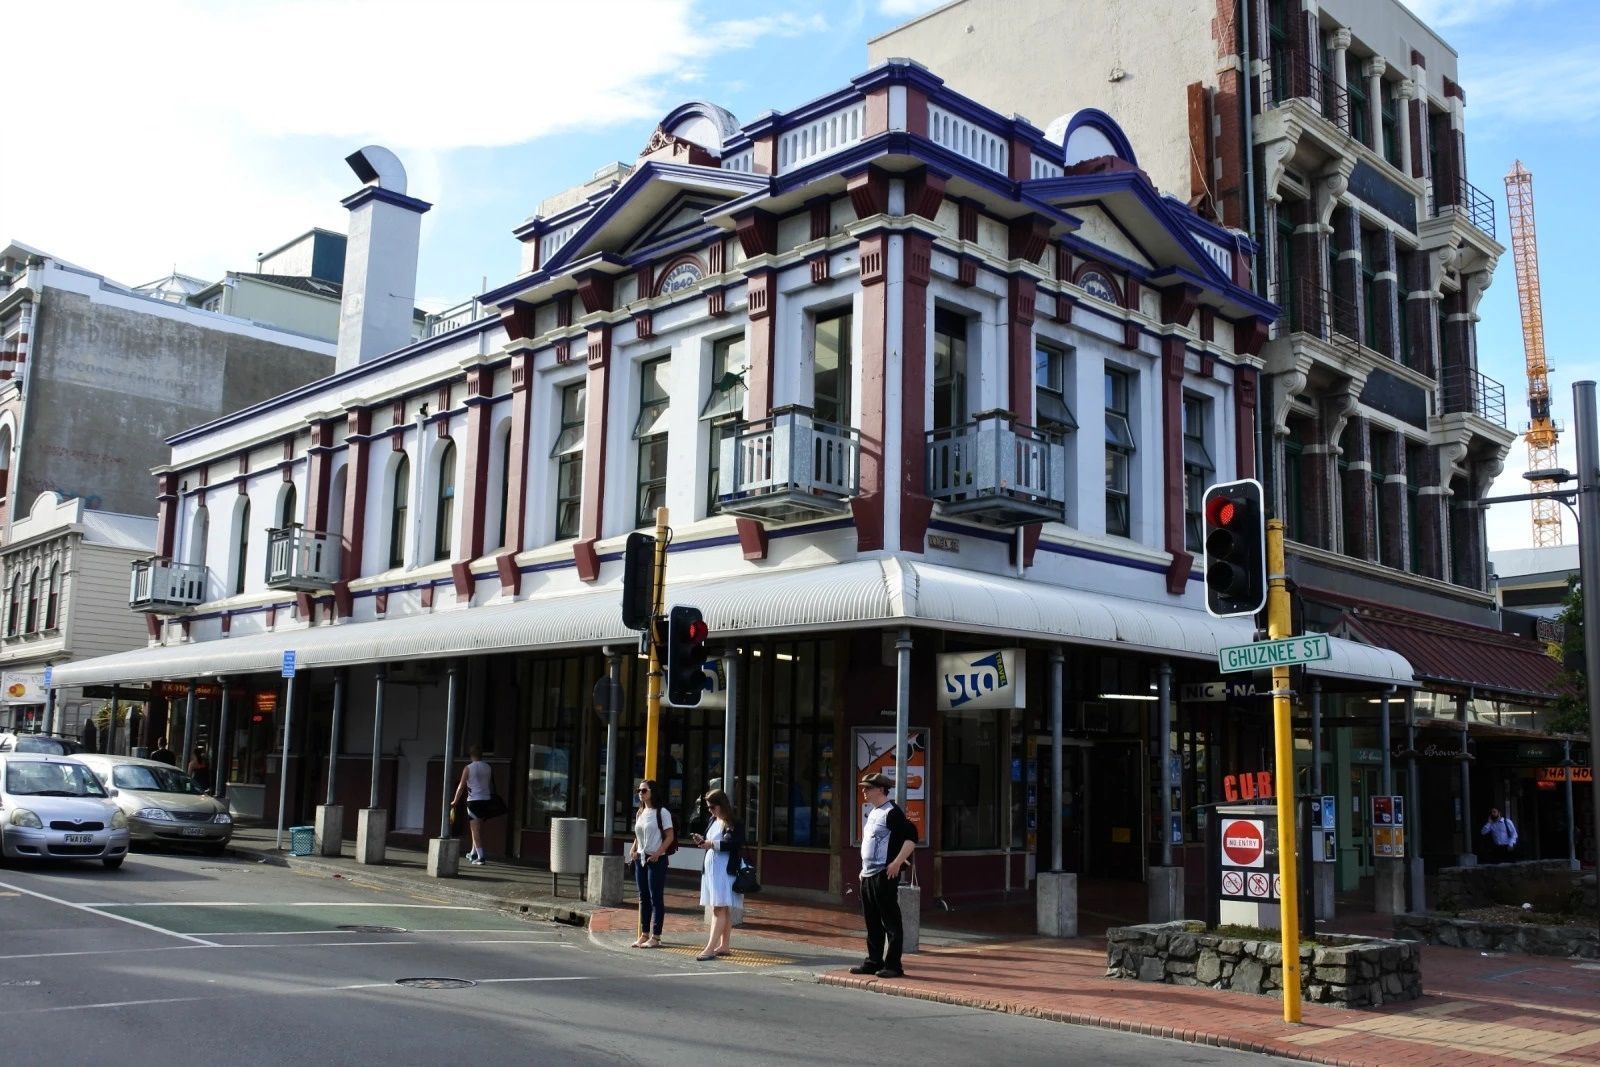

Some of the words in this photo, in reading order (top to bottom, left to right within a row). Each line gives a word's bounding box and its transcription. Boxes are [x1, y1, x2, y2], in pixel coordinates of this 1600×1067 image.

[1228, 642, 1296, 667] GHUZNEE
[1303, 639, 1321, 658] ST
[996, 652, 1007, 685] TRAVEL
[1186, 685, 1215, 698] NIC
[1233, 684, 1257, 697] NA
[1223, 771, 1273, 802] CUB
[1545, 768, 1568, 778] THA
